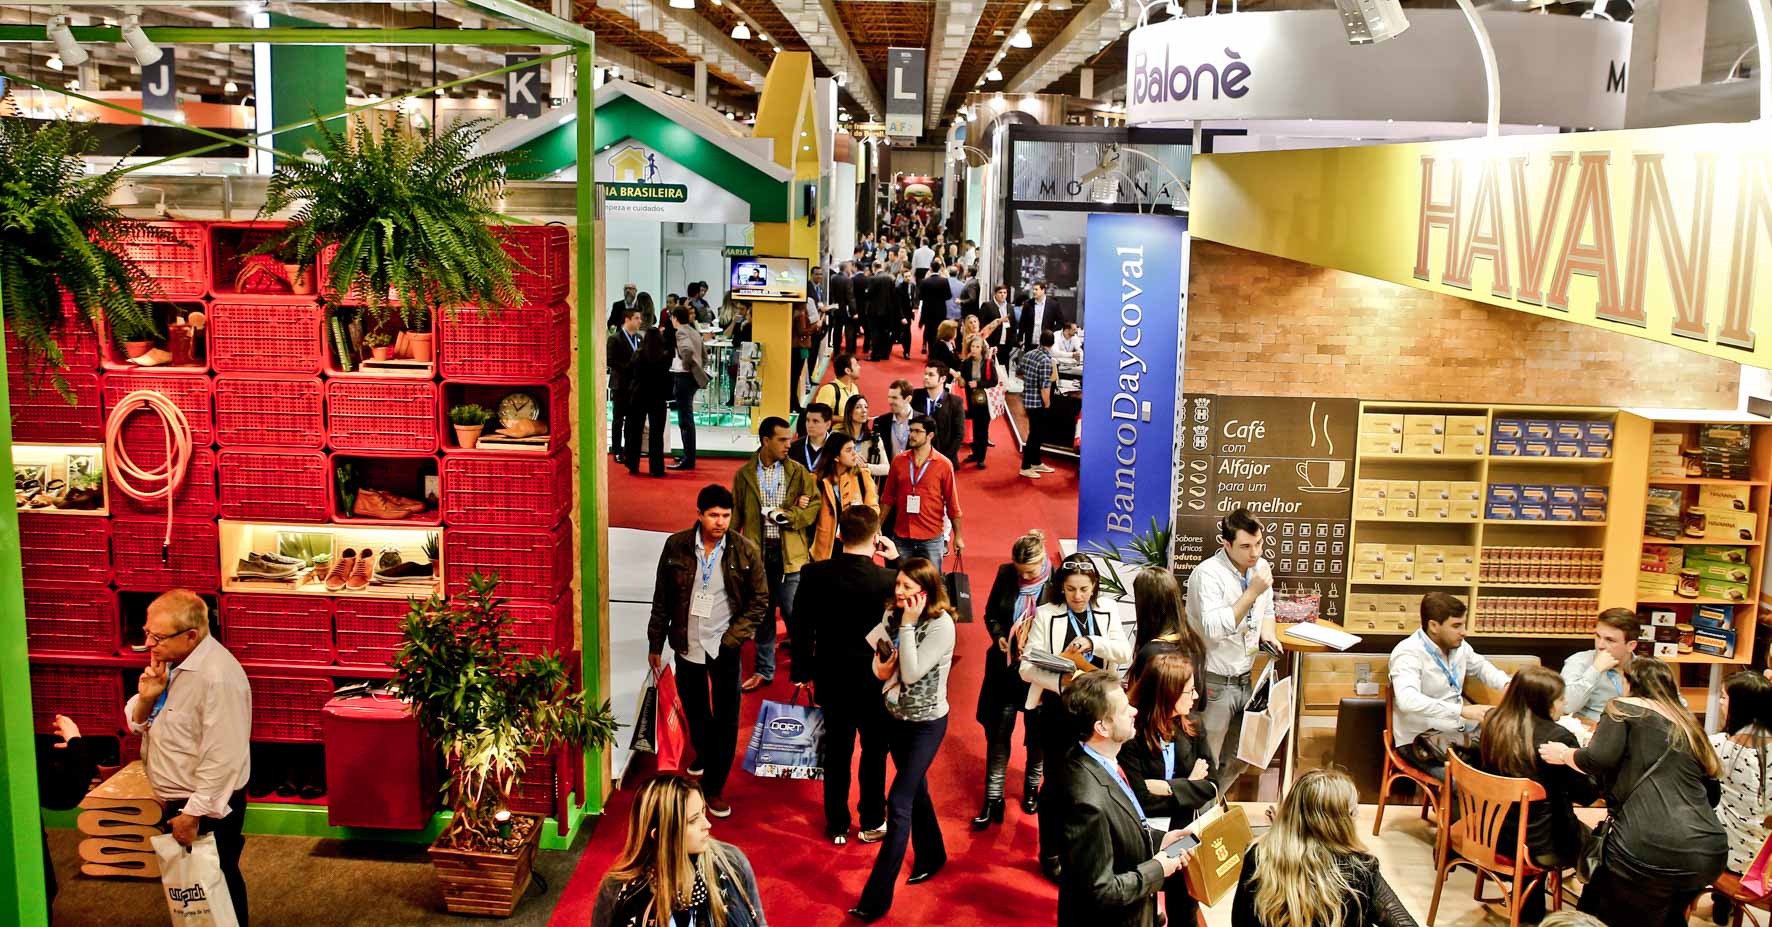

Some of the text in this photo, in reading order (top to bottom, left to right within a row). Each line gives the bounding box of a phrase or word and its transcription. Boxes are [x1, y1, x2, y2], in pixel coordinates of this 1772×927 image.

[148, 65, 169, 96] J
[894, 67, 917, 99] L
[1133, 43, 1251, 105] Balonè
[509, 71, 537, 104] K
[620, 187, 683, 198] BRASILEIRA
[1106, 244, 1147, 534] BancoDaycoval
[1223, 419, 1266, 443] Café
[1221, 444, 1247, 453] com
[1217, 458, 1271, 480] Alfajor
[1217, 481, 1267, 495] para um
[1217, 496, 1303, 513] dia melhor
[1175, 534, 1204, 543] Sabores
[1180, 543, 1202, 552] únicos
[771, 721, 802, 732] DORT
